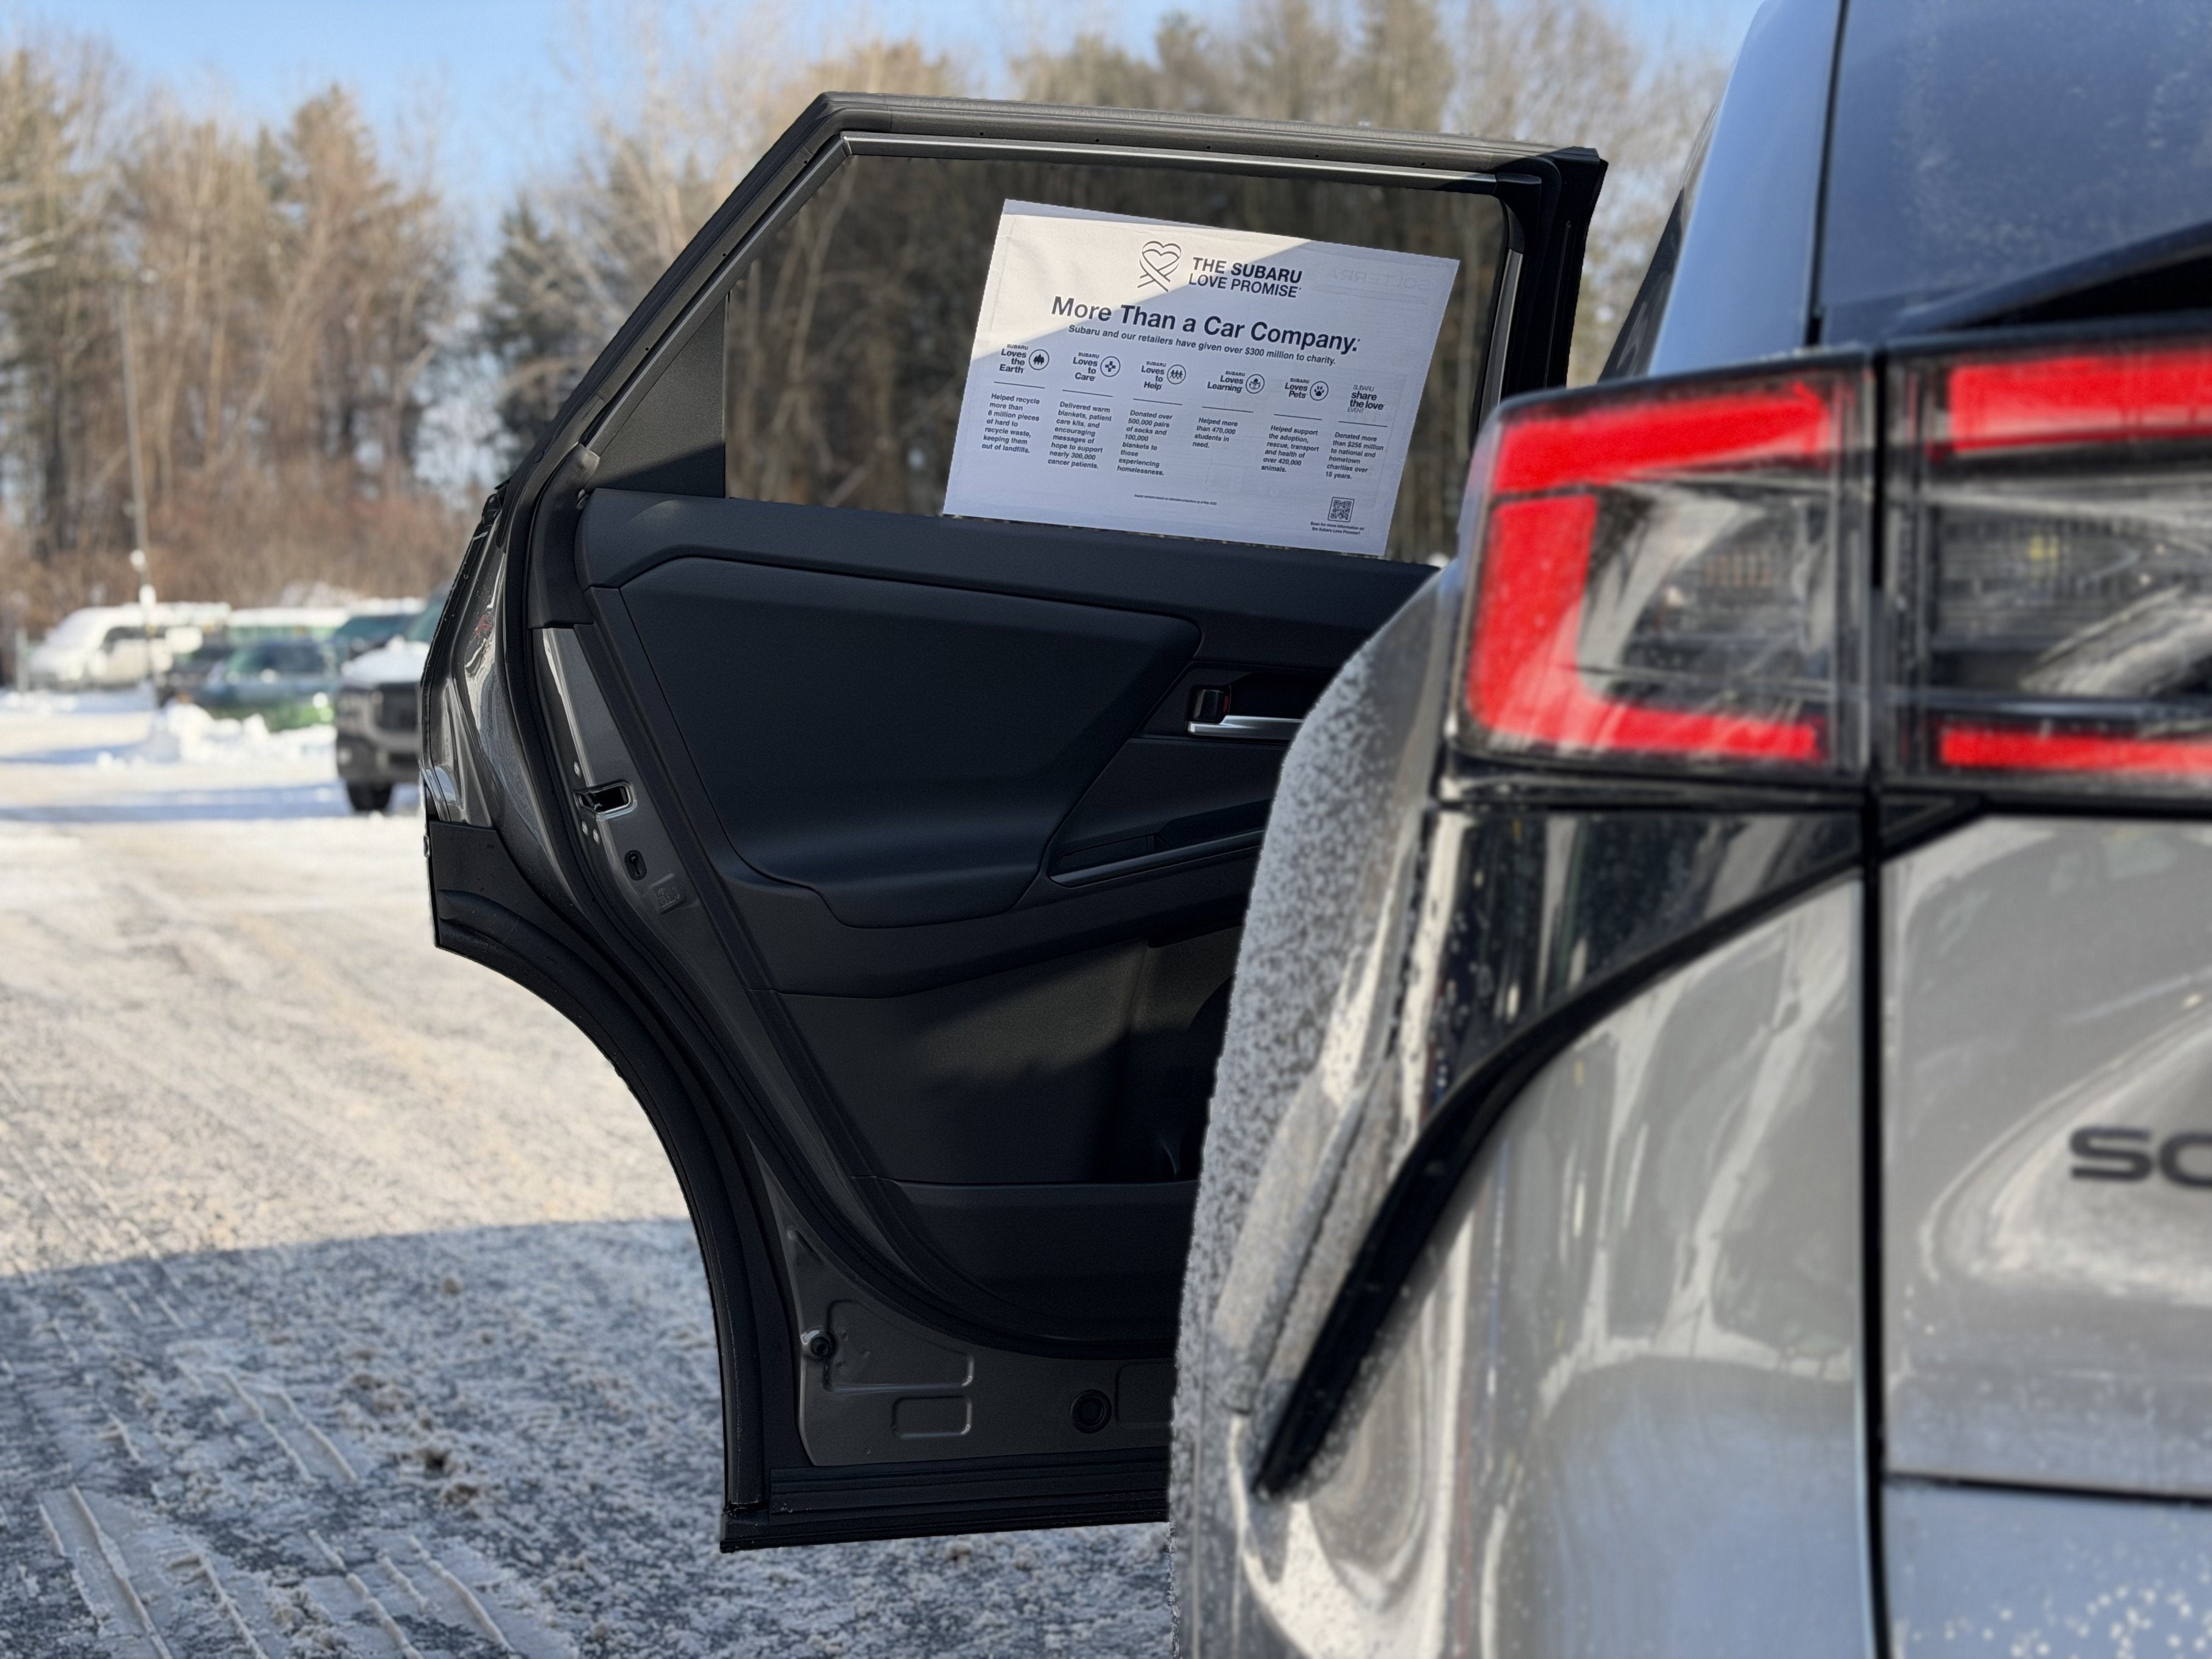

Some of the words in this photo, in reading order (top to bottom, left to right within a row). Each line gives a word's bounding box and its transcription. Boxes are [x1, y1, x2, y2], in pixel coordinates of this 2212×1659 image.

[1193, 257, 1227, 274] THE
[1231, 262, 1303, 284] SUBARU
[1188, 273, 1228, 289] LOVE
[1051, 296, 1112, 321] More
[1120, 304, 1176, 330] Than
[1182, 318, 1197, 333] a
[1204, 315, 1245, 338] Car
[1068, 324, 1101, 336] Subaru
[1102, 330, 1120, 338] and
[1138, 335, 1173, 346] retailers
[1175, 338, 1197, 348] have
[1198, 341, 1222, 352] given
[1244, 347, 1265, 357] $300
[1266, 349, 1294, 360] million
[1296, 353, 1305, 361] to
[1306, 354, 1336, 366] charity.
[1001, 348, 1027, 358] Loves
[1011, 357, 1025, 366] the
[1073, 356, 1098, 367] Loves
[1087, 366, 1097, 375] to
[1141, 365, 1165, 375] Loves
[1220, 375, 1244, 385] Loves
[1143, 381, 1163, 391] Help
[1207, 381, 1244, 394] Learning
[1284, 382, 1308, 392] Loves
[1352, 384, 1375, 392] SUBARU
[991, 393, 1015, 402] Helped
[1015, 397, 1040, 405] recycle
[1288, 390, 1307, 399] Pets
[1351, 391, 1378, 401] share
[1008, 403, 1023, 411] than
[1059, 401, 1091, 411] Delivered
[1350, 399, 1364, 408] the
[1364, 400, 1385, 410] love
[993, 410, 1017, 419] million
[1017, 413, 1040, 421] pieces
[1058, 409, 1087, 420] blankets,
[1130, 409, 1158, 419] Donated
[1072, 419, 1086, 428] kits,
[1127, 417, 1153, 426] 500,000
[1198, 417, 1221, 426] Helped
[984, 427, 1009, 435] recycle
[1010, 430, 1031, 438] waste,
[1054, 427, 1096, 438] encouraging
[1270, 425, 1293, 433] Helped
[983, 434, 1010, 444] keeping
[1052, 435, 1086, 444] messages
[1125, 433, 1149, 442] 100,000
[1194, 433, 1222, 442] students
[1279, 435, 1309, 444] adoption,
[1334, 431, 1361, 441] Donated
[1002, 444, 1030, 454] landfills.
[1051, 441, 1068, 450] hope
[1122, 441, 1149, 450] blankets
[1266, 442, 1289, 450] rescue,
[1290, 443, 1319, 452] transport
[1049, 450, 1070, 459] nearly
[1070, 452, 1096, 460] 300,000
[1277, 449, 1297, 458] health
[1338, 449, 1363, 457] national
[1118, 458, 1160, 469] experiencing
[1328, 455, 1361, 464] hometown
[1070, 461, 1099, 469] patients.
[1327, 464, 1353, 472] charities
[1116, 465, 1165, 476] homelessness.
